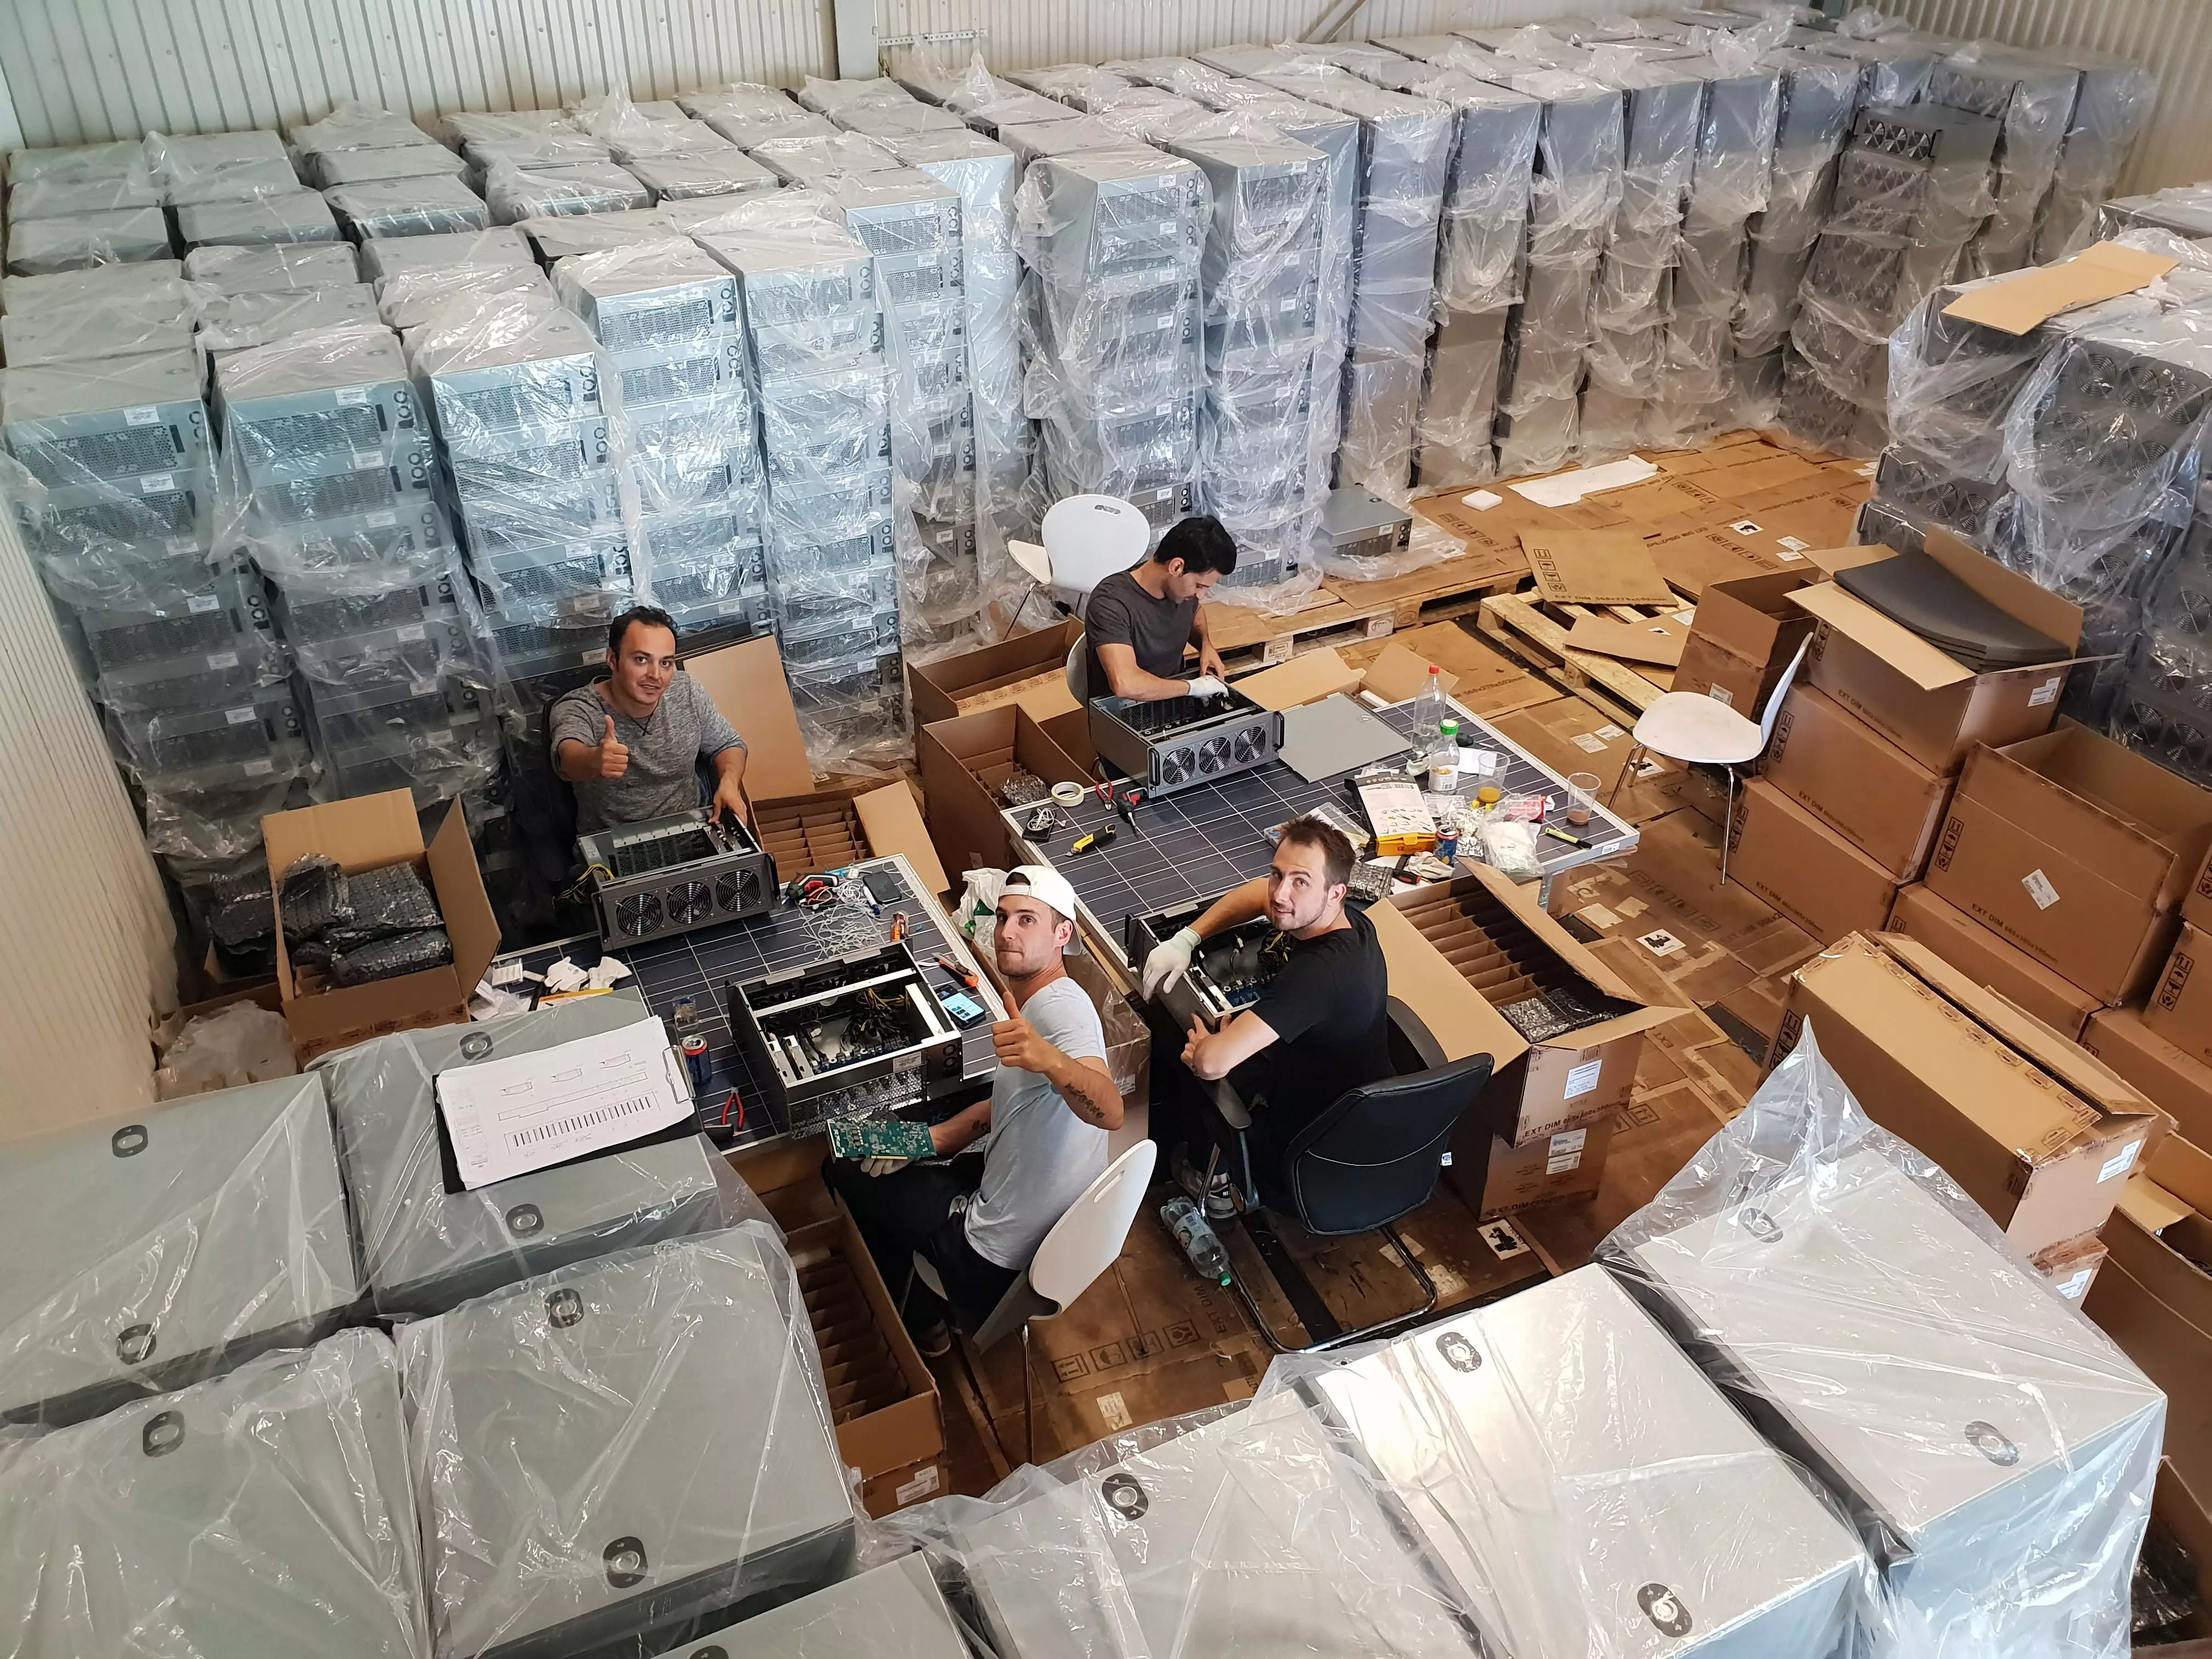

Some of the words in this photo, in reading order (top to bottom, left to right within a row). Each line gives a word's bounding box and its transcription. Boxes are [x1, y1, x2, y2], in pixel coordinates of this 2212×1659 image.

[1838, 689, 1850, 701] EXT
[1850, 698, 1862, 709] DIM
[1798, 791, 1811, 803] EXT
[1812, 800, 1824, 812] DIM
[1756, 881, 1768, 892] EXT
[1769, 890, 1781, 901] DIM
[1971, 902, 1988, 916] EXT
[1988, 913, 2004, 928] DIM
[1652, 1031, 1674, 1048] EXT
[1525, 1126, 1544, 1137] EXT
[1544, 1119, 1561, 1130] DIM
[1511, 1201, 1528, 1211] DIM
[1194, 1285, 1212, 1307] DIM
[1206, 1311, 1227, 1334] EXT
